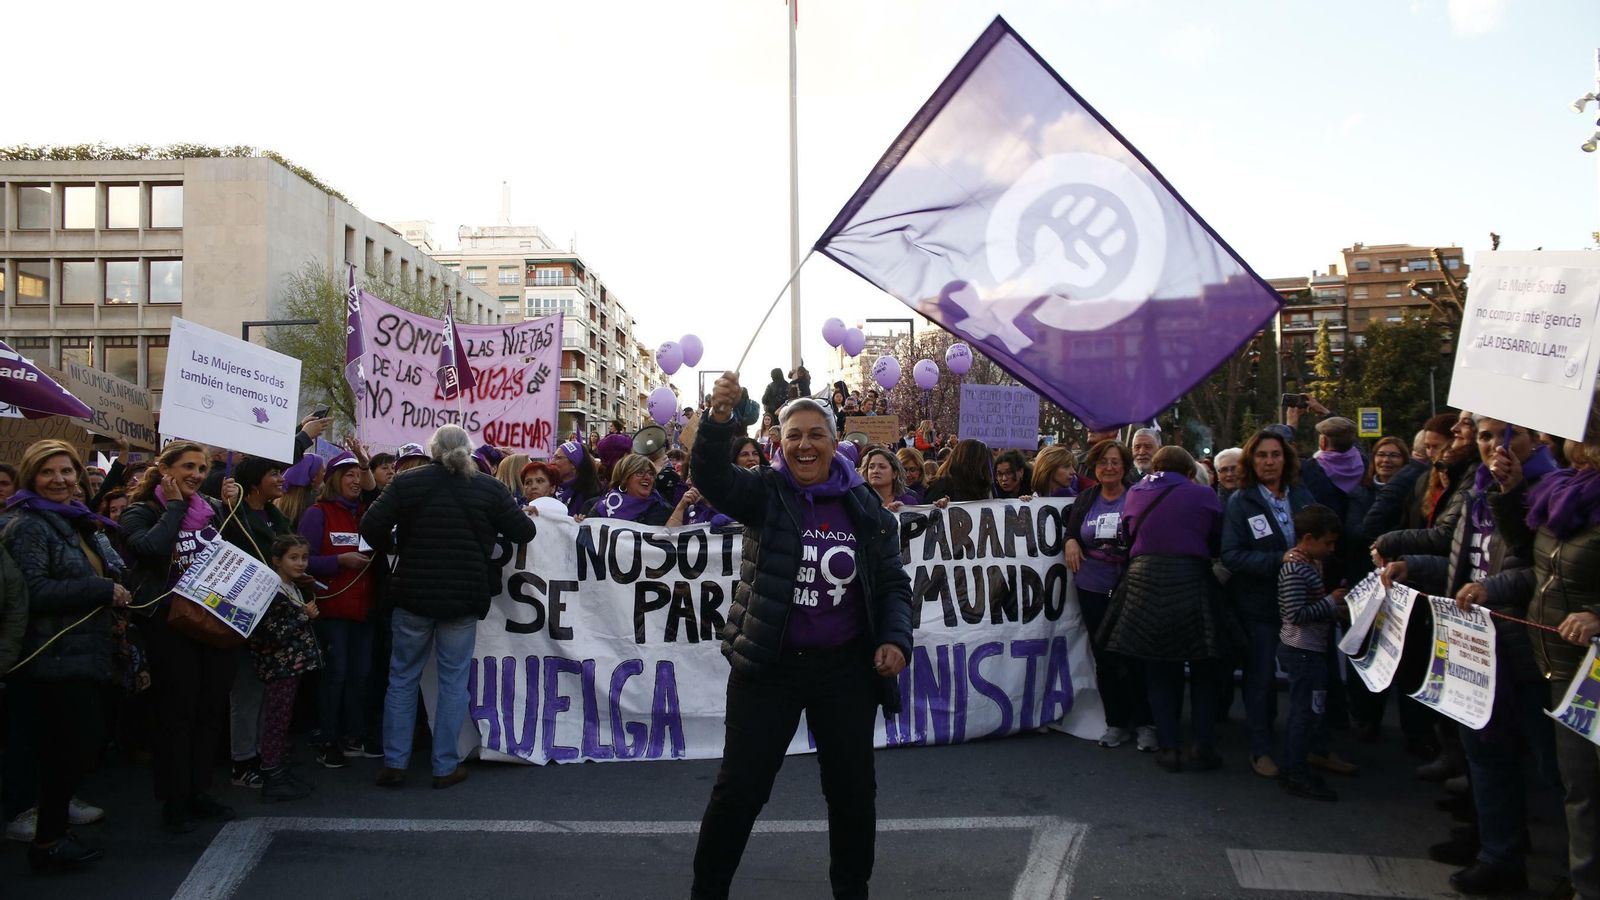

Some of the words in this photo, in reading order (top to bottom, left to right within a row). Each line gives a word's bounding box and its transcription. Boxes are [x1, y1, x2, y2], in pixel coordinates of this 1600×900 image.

[1508, 279, 1536, 295] Mujer
[1476, 307, 1488, 318] no
[1489, 308, 1521, 322] compra
[1522, 310, 1582, 329] inteligencia
[467, 339, 495, 358] LAS
[502, 323, 554, 356] NIETAS
[1495, 336, 1568, 358] DESARROLLA!!!
[70, 364, 81, 381] NI
[191, 350, 209, 364] Las
[211, 356, 251, 379] Mujeres
[254, 370, 285, 389] Sordas
[373, 354, 391, 378] DE
[396, 359, 422, 386] LAS
[526, 363, 551, 394] QUE
[99, 397, 124, 413] SOMOS
[180, 368, 223, 390] también
[226, 382, 268, 403] tenemos
[270, 394, 289, 409] VOZ
[365, 380, 393, 419] NO
[483, 418, 552, 453] QUEMAR
[576, 524, 744, 584] NOSOT
[801, 529, 857, 542] ANADA
[177, 539, 220, 589] FEMINISTA
[225, 562, 259, 601] MANIFESTACIÓN
[505, 571, 579, 640] SE
[911, 563, 1067, 629] MUNDO
[1434, 602, 1488, 626] FEMINISTA
[1448, 662, 1489, 689] MANIFESTACIÓN
[468, 655, 686, 760] HUELGA
[885, 635, 1075, 747] INISTA
